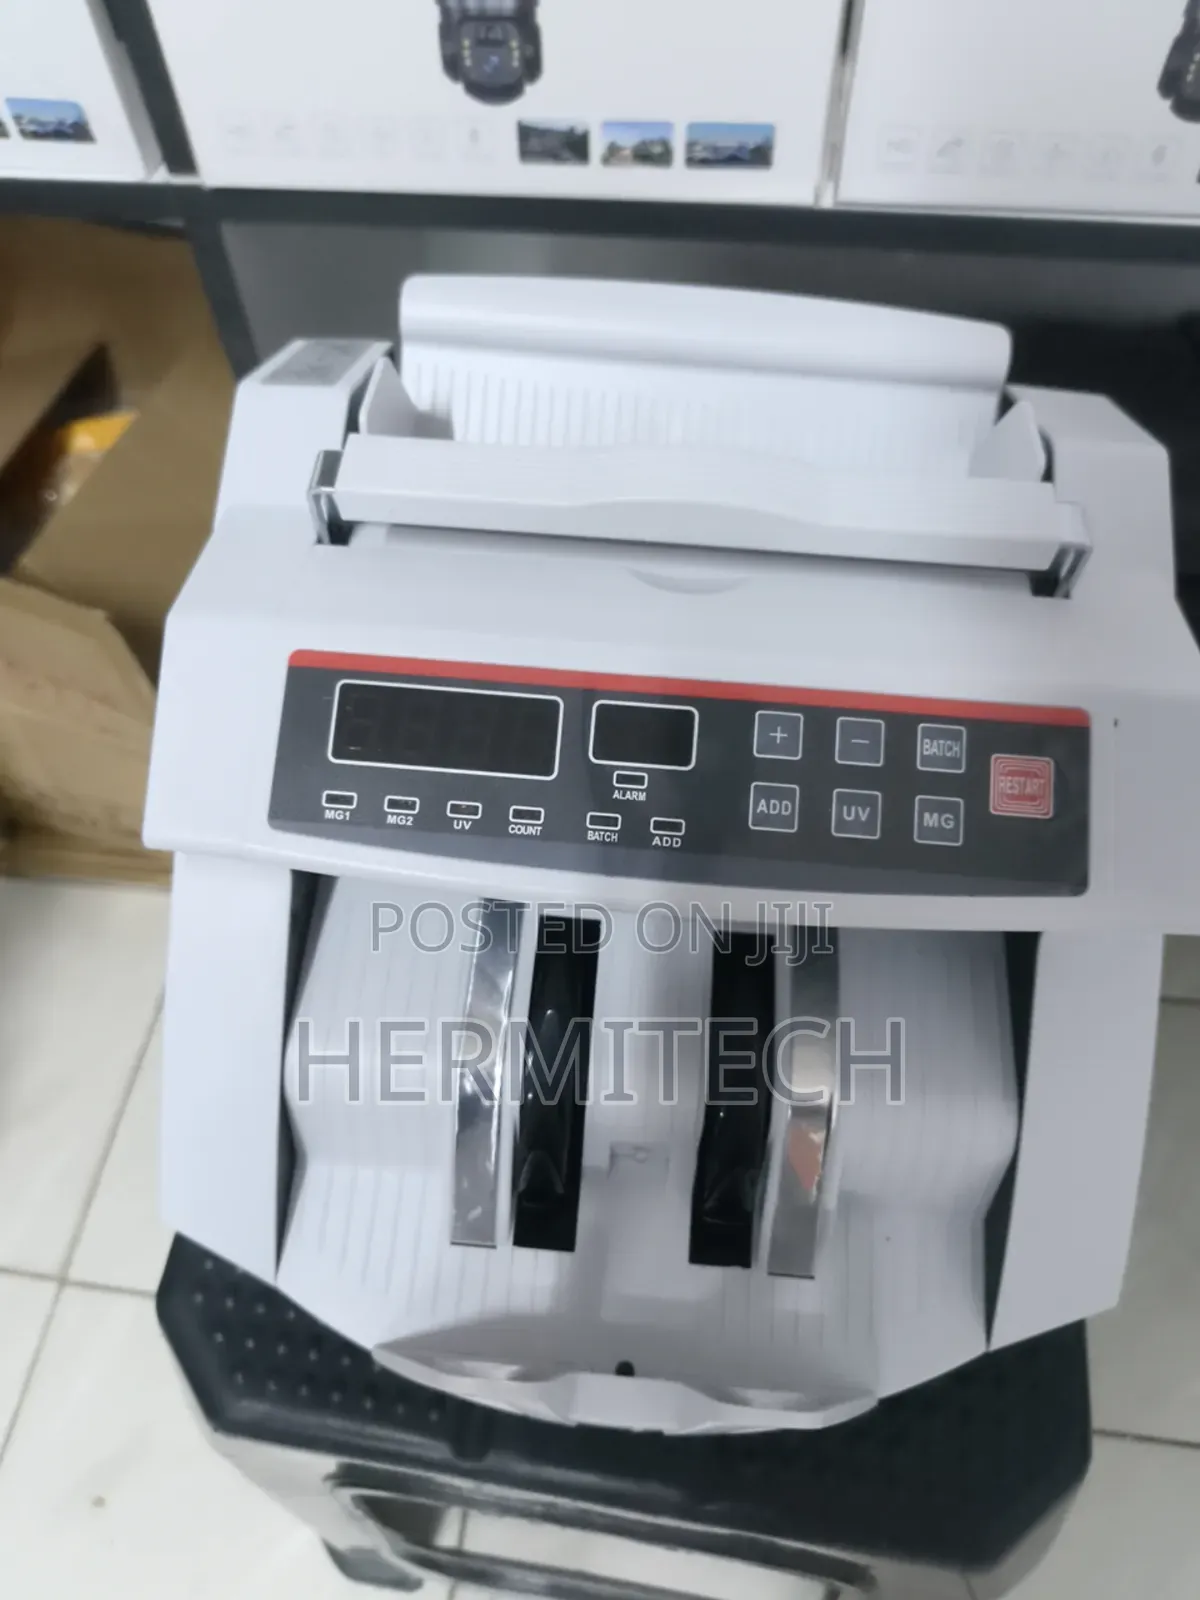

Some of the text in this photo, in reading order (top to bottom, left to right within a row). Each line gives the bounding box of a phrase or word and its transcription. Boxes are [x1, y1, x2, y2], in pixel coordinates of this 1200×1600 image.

[923, 738, 960, 758] BATCH
[998, 776, 1045, 796] RESTART
[613, 789, 647, 802] ALARM
[756, 798, 792, 816] ADD
[842, 805, 870, 822] UV
[324, 809, 351, 822] MG1
[386, 814, 414, 827] MG2
[923, 812, 955, 829] MG
[453, 819, 473, 831] UV
[508, 824, 542, 837] COUNT
[587, 830, 619, 843] BATCH
[652, 835, 682, 848] ADD
